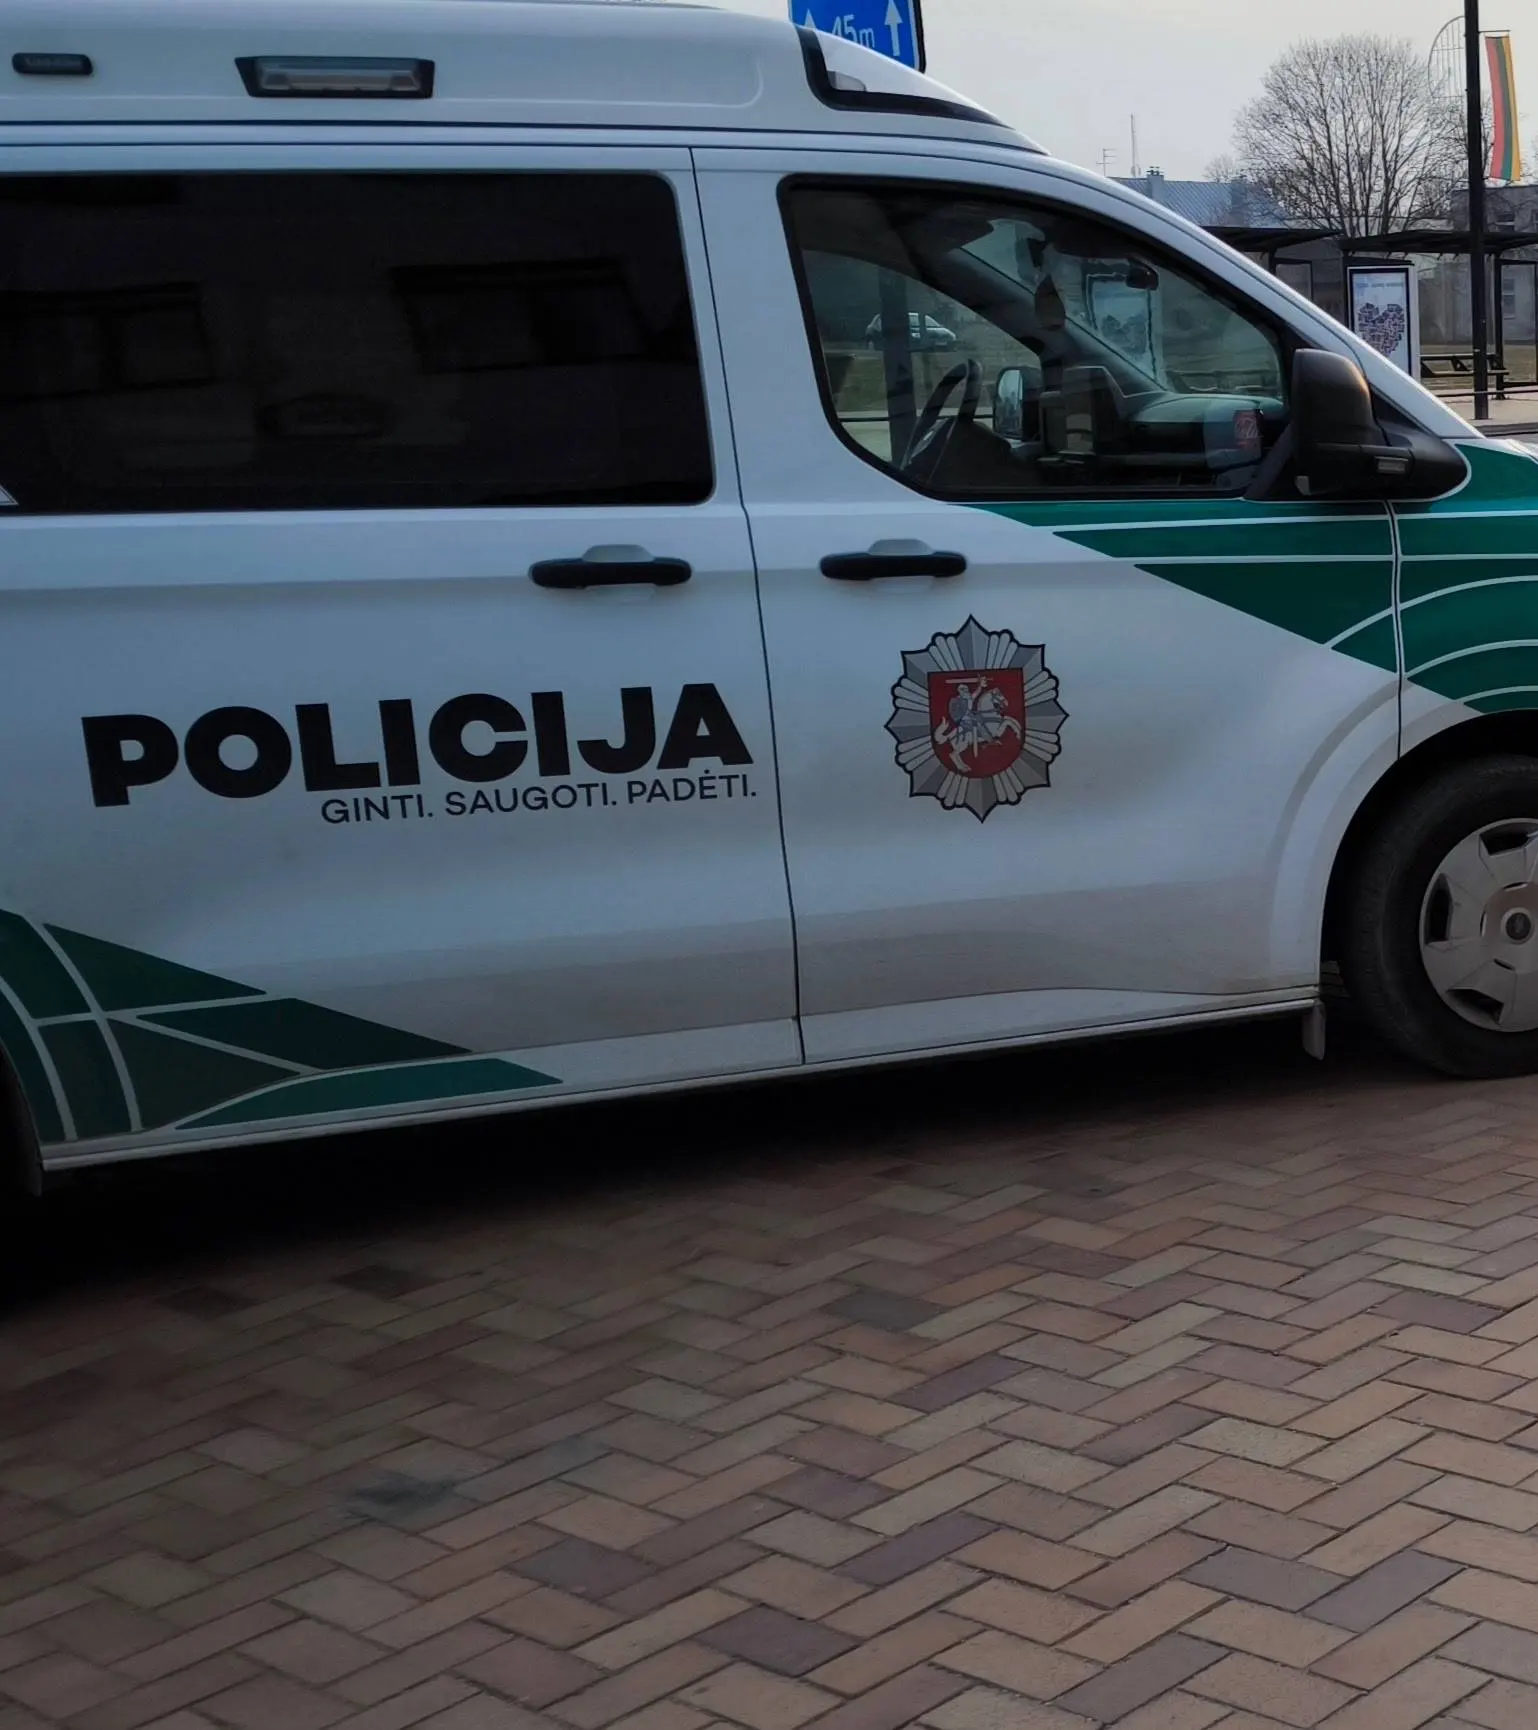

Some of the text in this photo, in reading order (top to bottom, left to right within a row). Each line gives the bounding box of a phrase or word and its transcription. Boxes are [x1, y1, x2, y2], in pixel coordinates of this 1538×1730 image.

[80, 682, 755, 808] POLICIJA
[320, 768, 758, 825] GINTI. SAUGOTI. PADĖTI.
